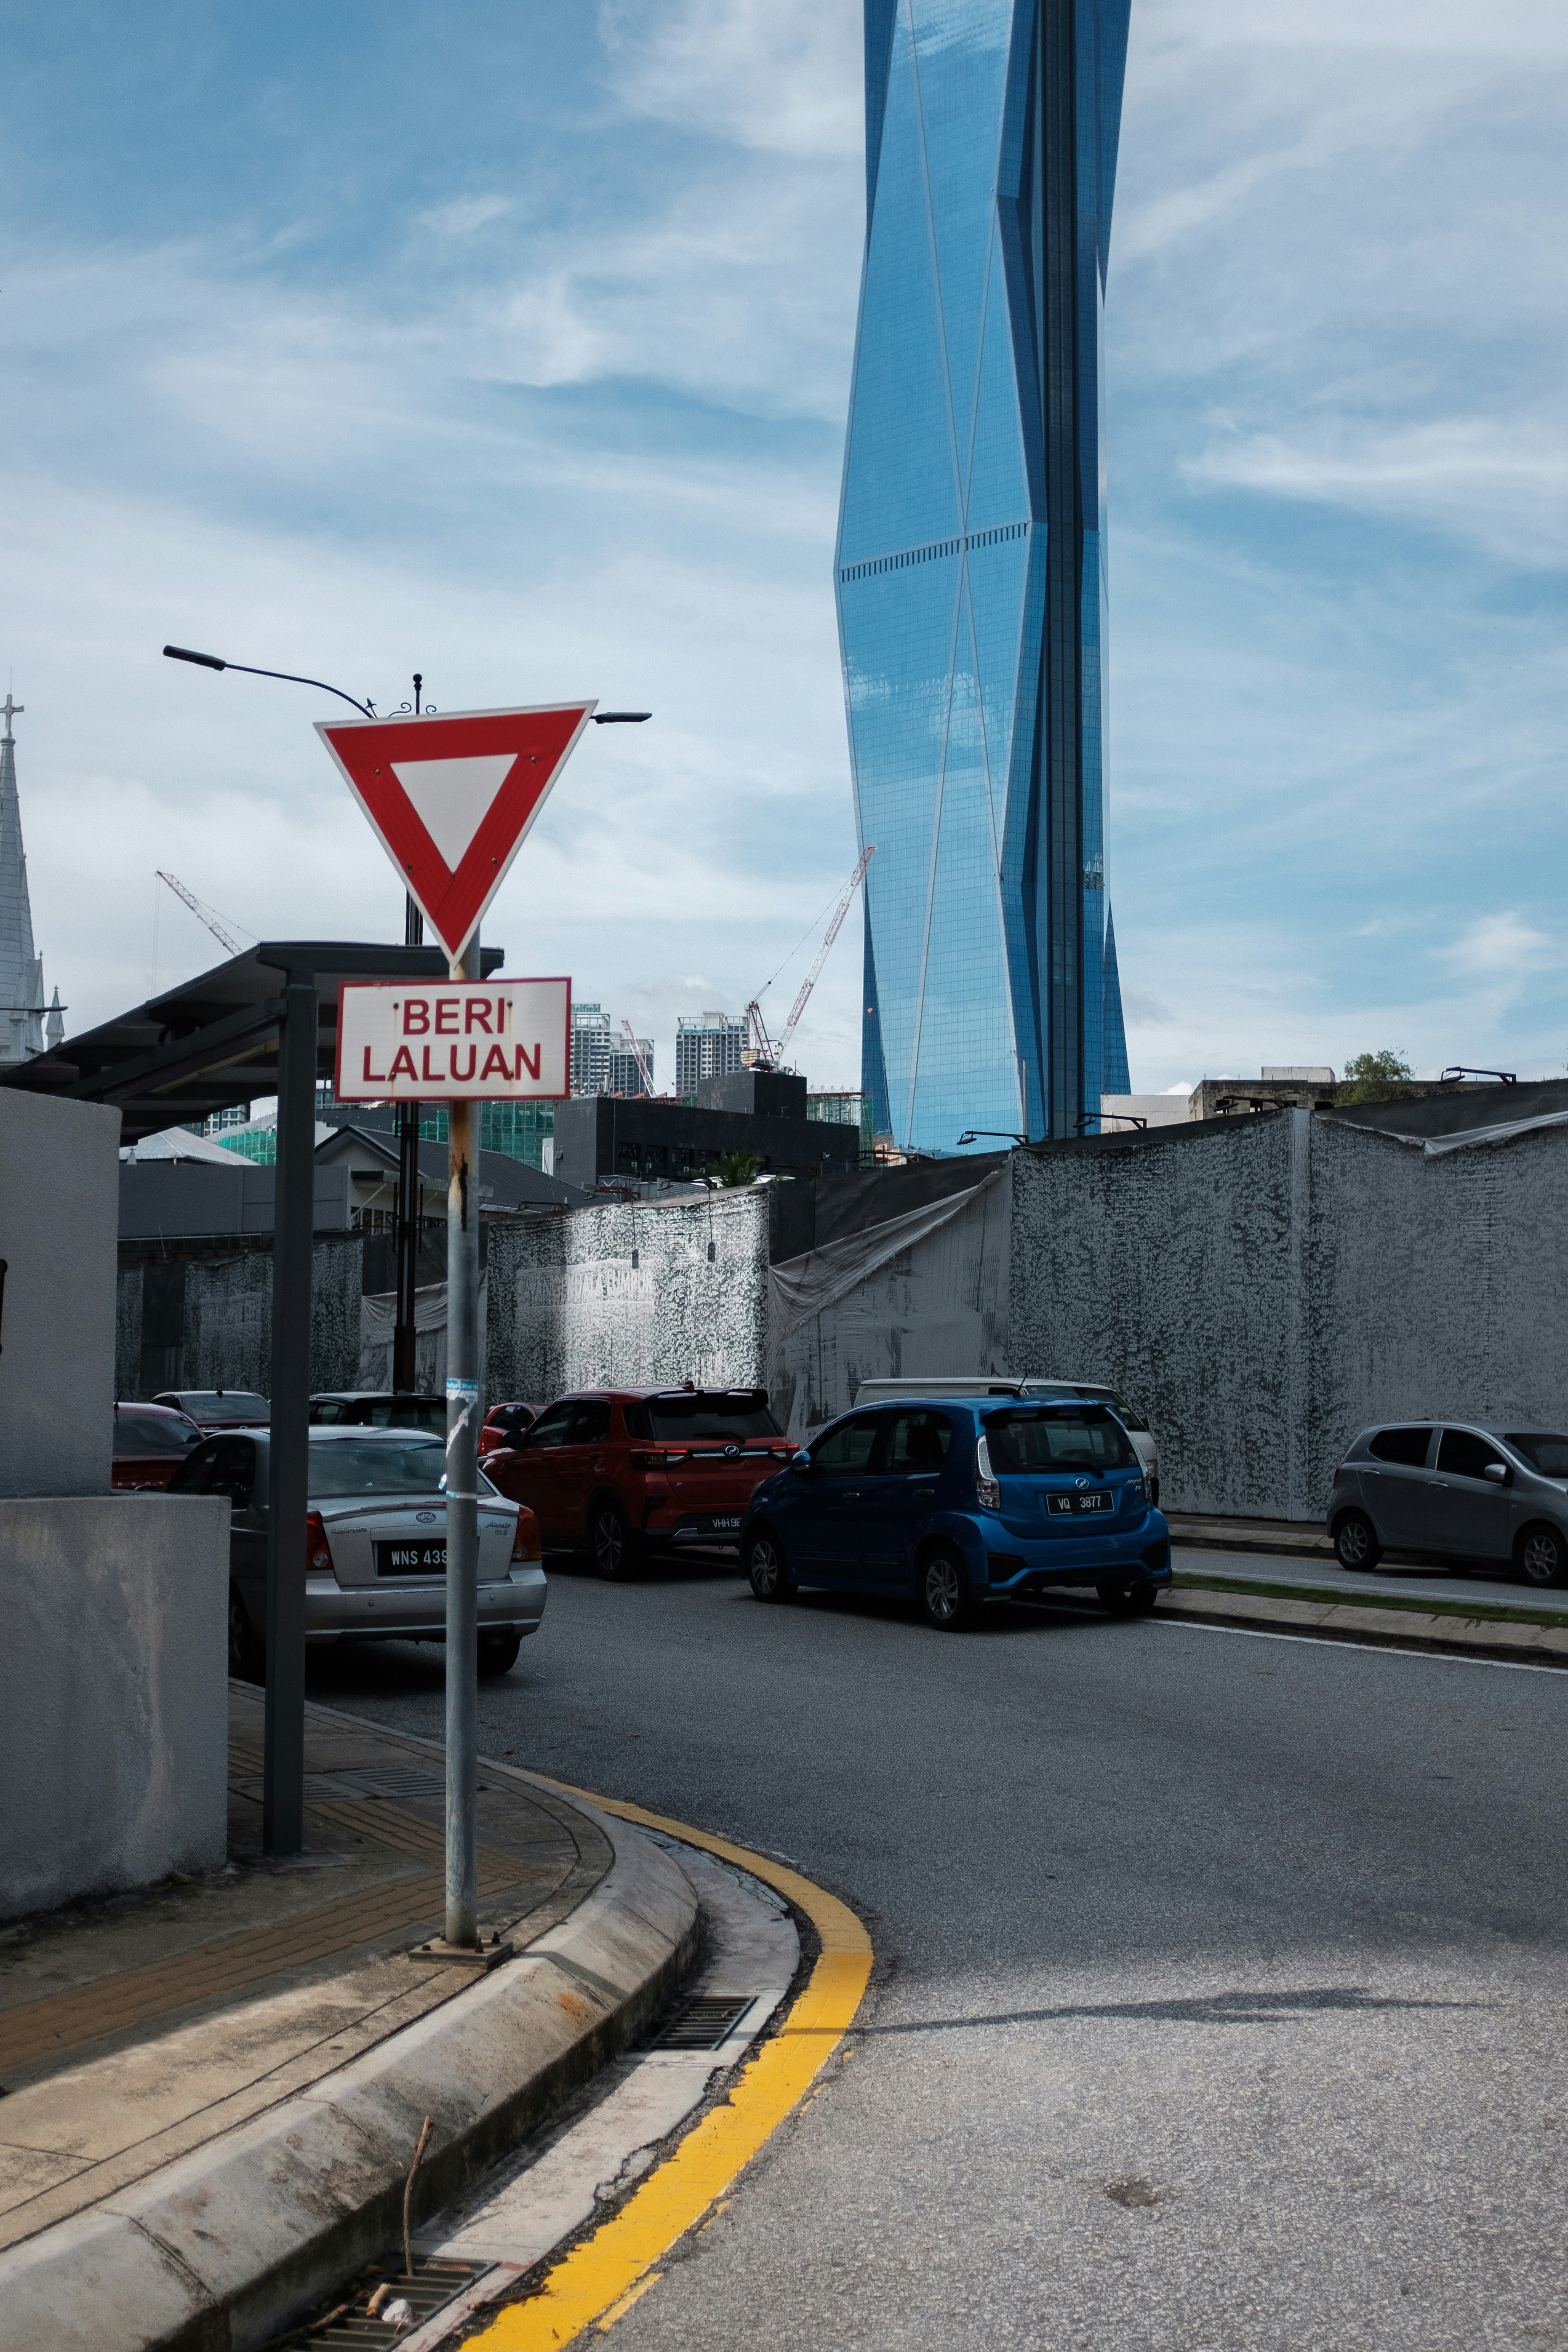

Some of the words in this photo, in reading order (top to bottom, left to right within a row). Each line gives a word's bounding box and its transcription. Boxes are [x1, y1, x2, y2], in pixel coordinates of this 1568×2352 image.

[403, 997, 505, 1035] BERI
[363, 1044, 541, 1081] LALUAN
[1058, 1498, 1070, 1509] VQ
[1079, 1496, 1101, 1508] 3877
[712, 1519, 730, 1528] VHH
[391, 1550, 418, 1565] WNS
